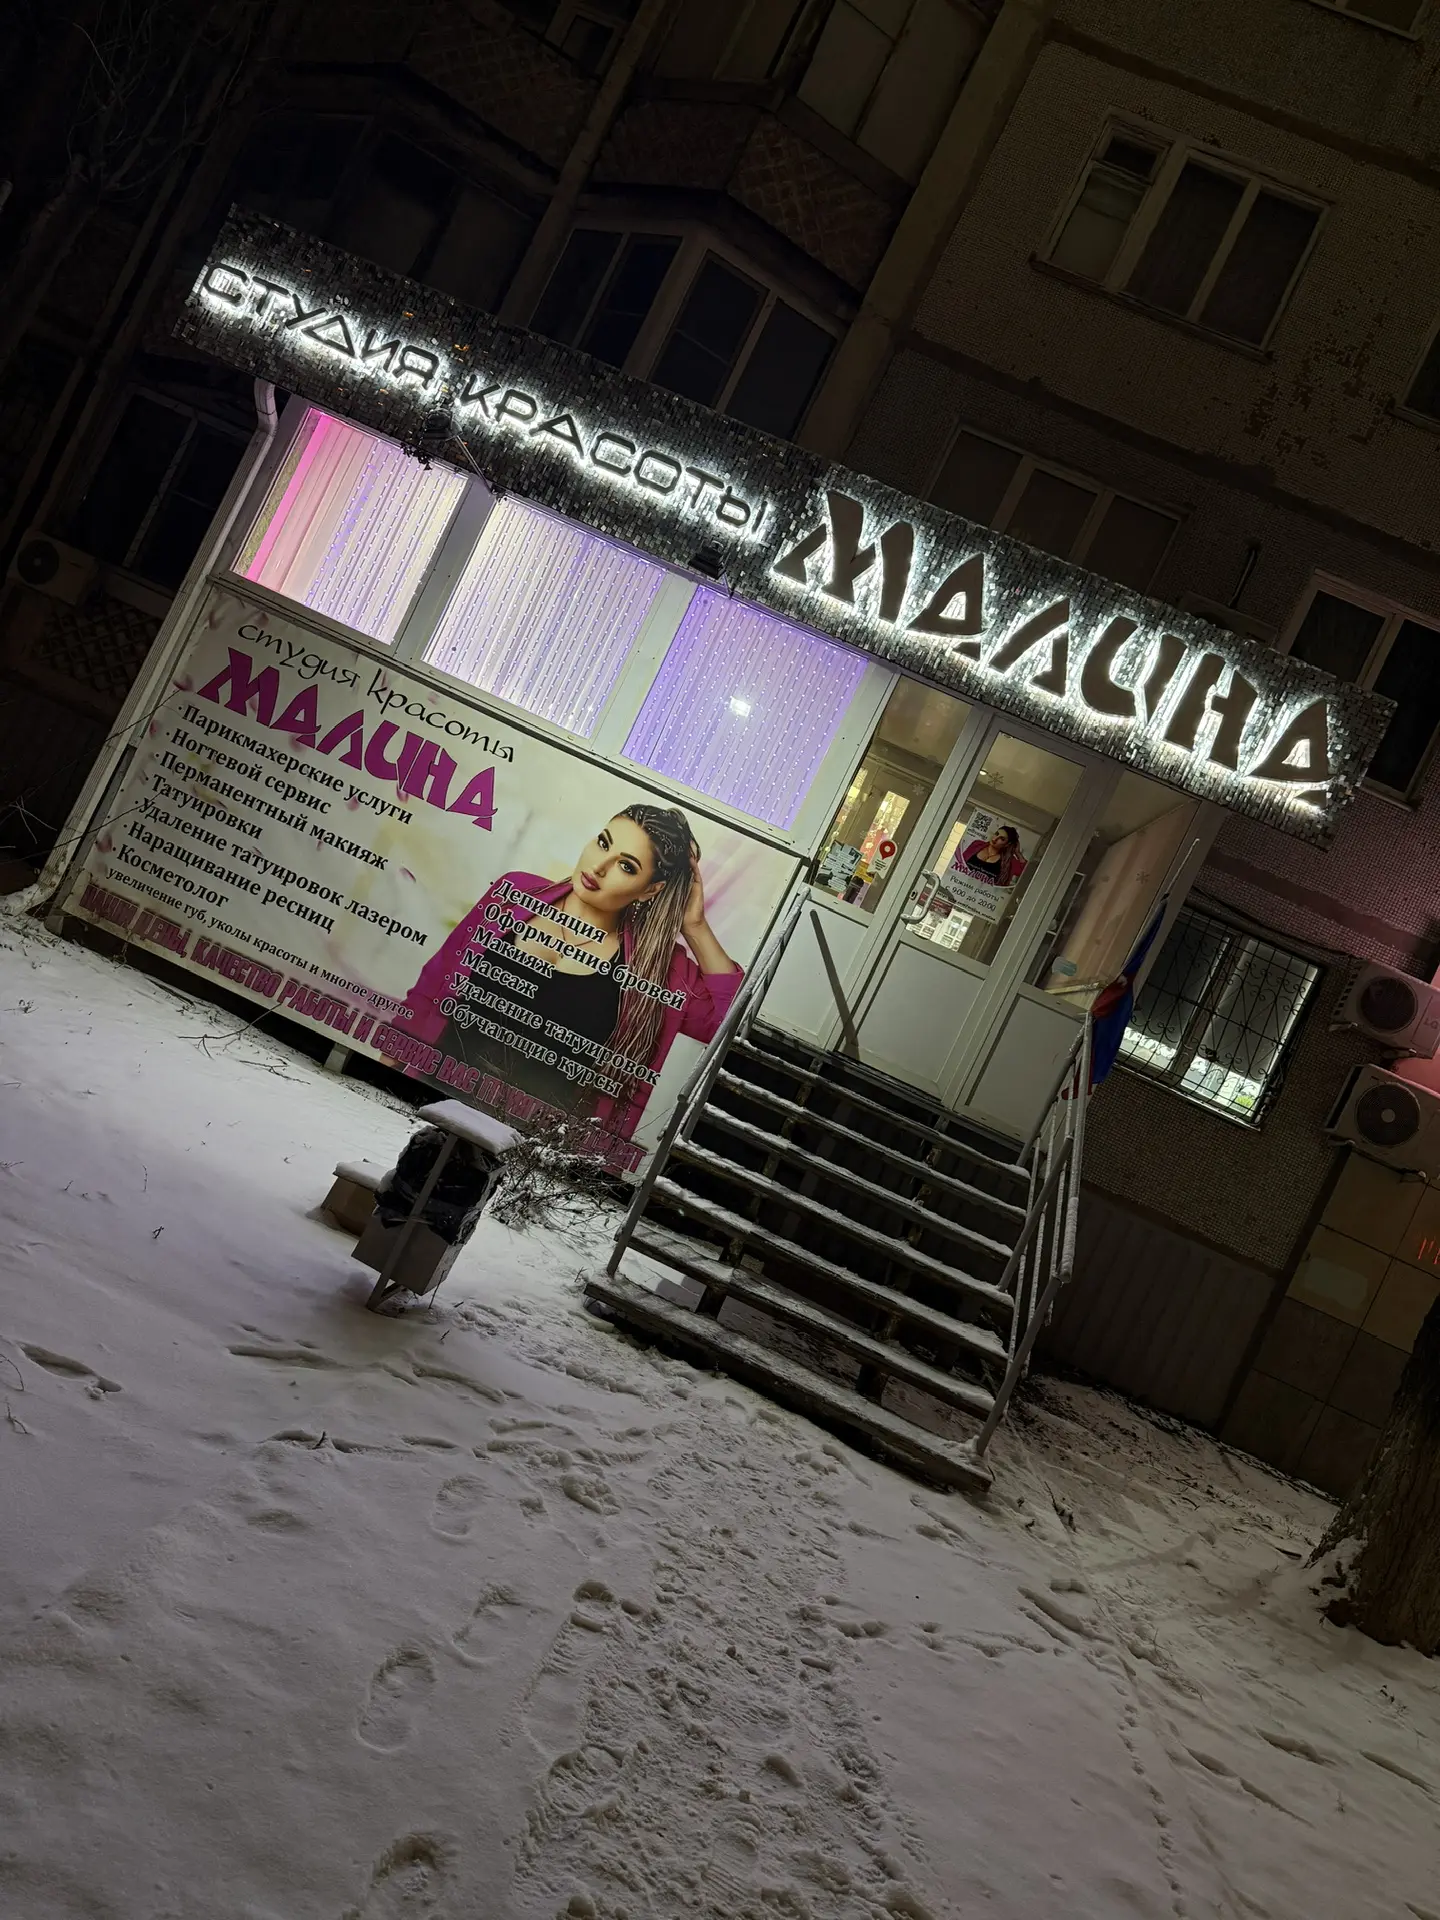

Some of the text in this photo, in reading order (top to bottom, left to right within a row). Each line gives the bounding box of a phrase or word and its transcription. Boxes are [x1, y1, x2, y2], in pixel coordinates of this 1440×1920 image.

[202, 263, 768, 532] СТУДИЯ КРАСОТЫ
[237, 624, 515, 762] студия красоты
[772, 491, 1336, 806] МАЛИНА
[170, 728, 332, 815] Ногтевой сервис
[181, 704, 413, 825] Парикмахерские услуги
[196, 646, 498, 831] МАЛИНА
[152, 773, 263, 840] Татуировки
[158, 751, 388, 871] Перманентный макияж
[116, 844, 230, 908] Косметолог
[127, 821, 336, 934] Наращивание ресниц
[139, 796, 428, 946] Удаление татуировок лазером
[493, 880, 608, 944] Депиляция
[950, 875, 999, 901] Режим работы
[106, 867, 414, 1020] увеличение губ, уколы красоты и многое другое
[460, 949, 539, 998] Массаж
[471, 925, 556, 979] Макияж
[484, 903, 687, 1011] Оформление бровей
[189, 937, 285, 1000] КАЧЕСТВО
[277, 978, 358, 1036] РАБОТЫ
[353, 1015, 376, 1043] И
[369, 1022, 443, 1076] СЕРВИС
[436, 1054, 480, 1095] ВАС
[439, 998, 623, 1098] Обучающие курсы
[449, 972, 661, 1086] Удаление татуировок
